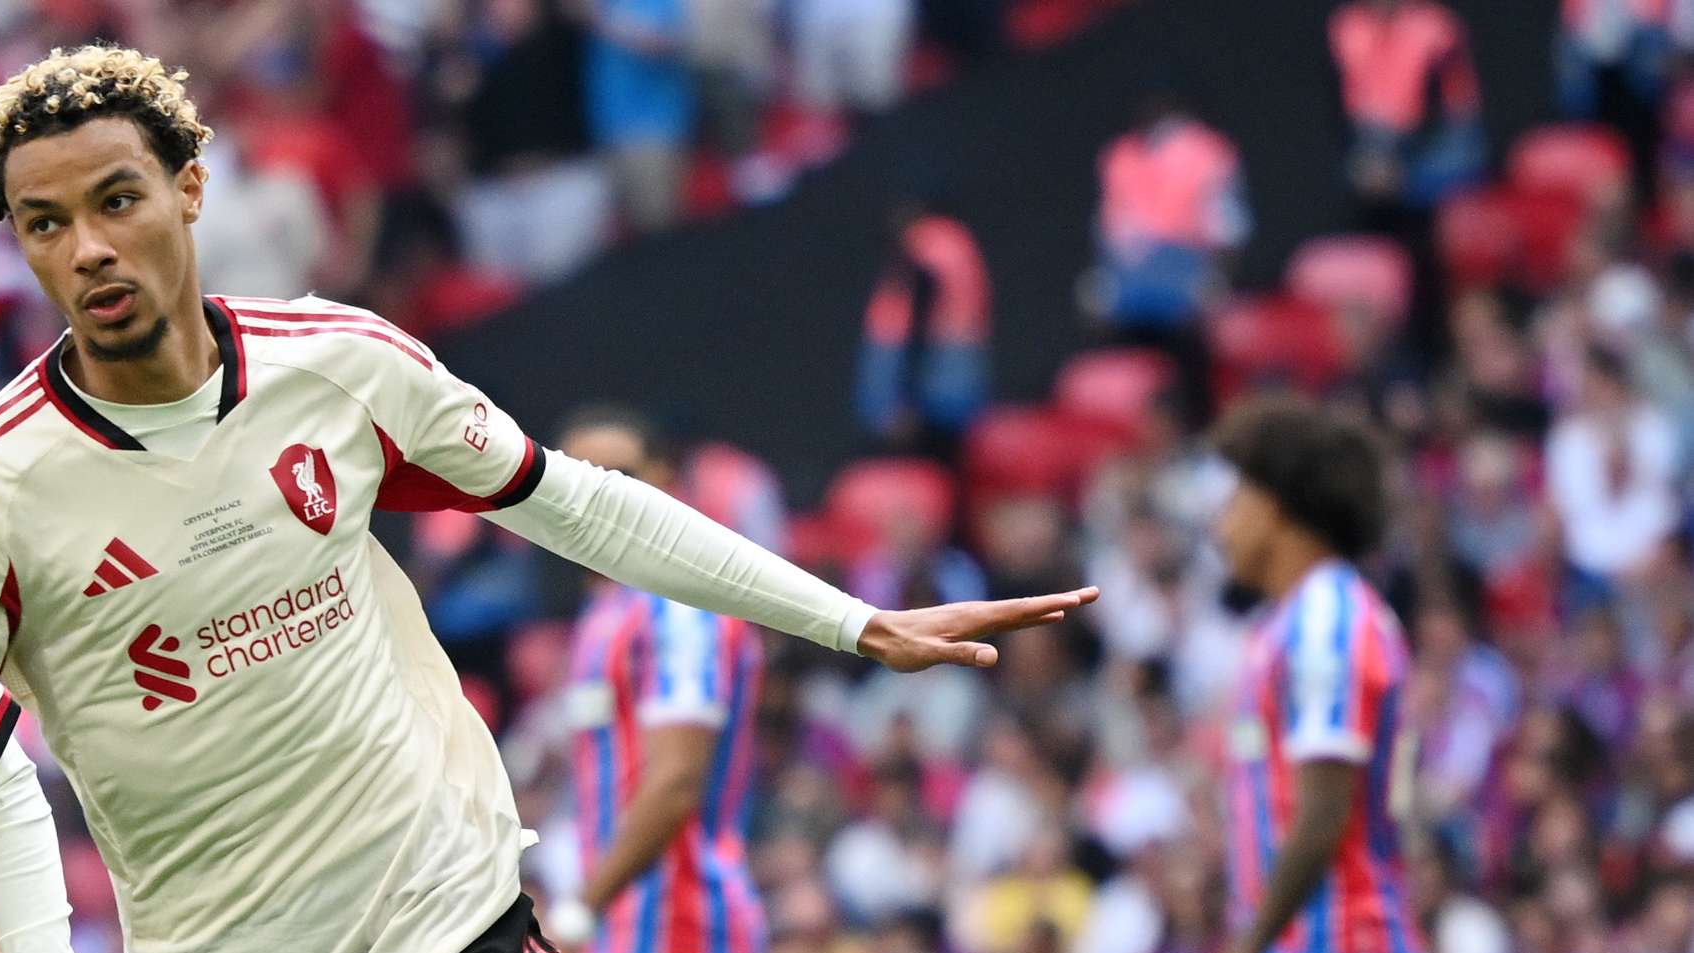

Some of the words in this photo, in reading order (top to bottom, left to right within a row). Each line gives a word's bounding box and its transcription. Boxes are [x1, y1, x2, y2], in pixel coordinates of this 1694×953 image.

[183, 510, 214, 526] CRYSTAL
[214, 499, 242, 514] PALACE
[194, 522, 234, 541] LIVERPOOL
[209, 529, 237, 544] AUGUST
[197, 566, 344, 649] standard
[207, 591, 354, 677] chartered
